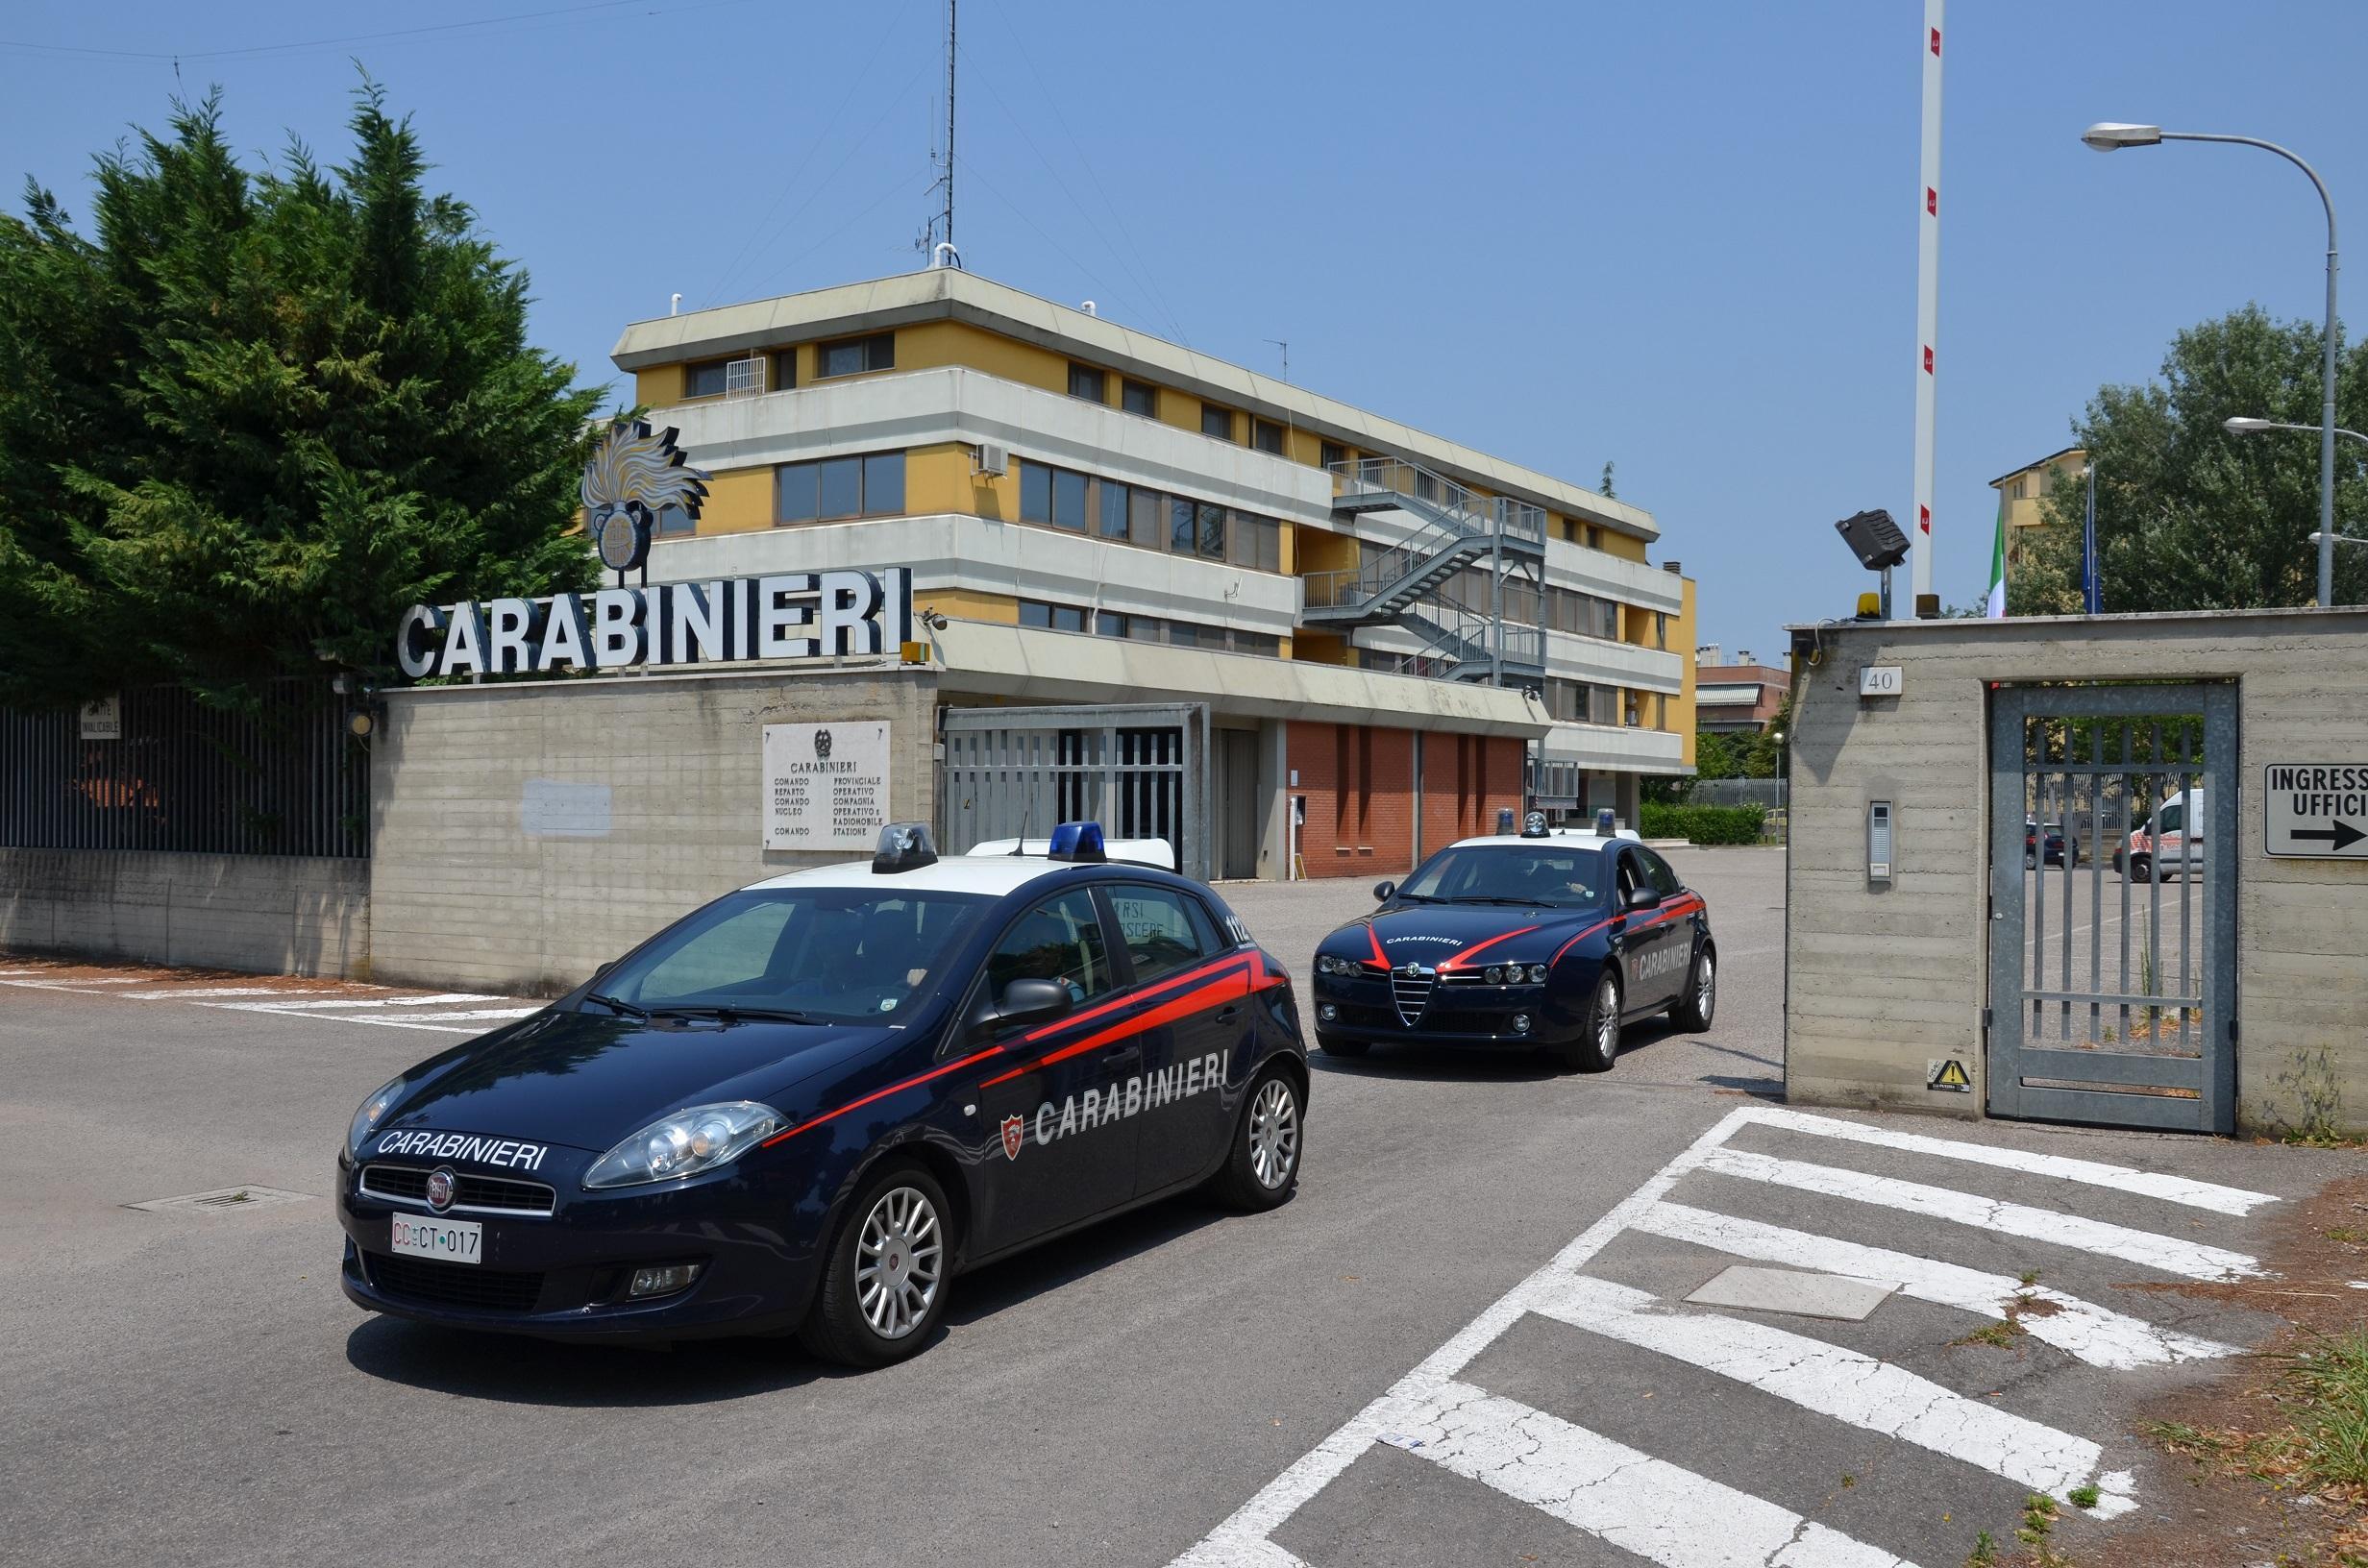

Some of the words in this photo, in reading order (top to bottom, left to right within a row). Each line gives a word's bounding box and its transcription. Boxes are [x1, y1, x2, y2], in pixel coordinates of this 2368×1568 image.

[398, 566, 913, 678] CARABINIERI
[1868, 673, 1892, 690] 40
[790, 761, 857, 774] CARABINIERI
[774, 777, 809, 786] COMANDO
[833, 776, 881, 786] PROVINCIALE
[775, 788, 805, 796] REPARTO
[832, 787, 875, 796] OPERATIVO
[775, 797, 810, 806] COMANDO
[832, 797, 875, 806] COMPAGNIA
[2293, 794, 2366, 816] UFFICI
[775, 807, 802, 816] NUCLEO
[832, 807, 875, 816] OPERATIVO
[775, 827, 810, 836] COMANDO
[832, 827, 867, 836] STAZIONE
[1386, 936, 1464, 946] CARABINIERI
[1640, 941, 1692, 981] CARABINIERI
[1035, 1048, 1229, 1146] CARABINIERI
[378, 1131, 548, 1170] CARABINIERI
